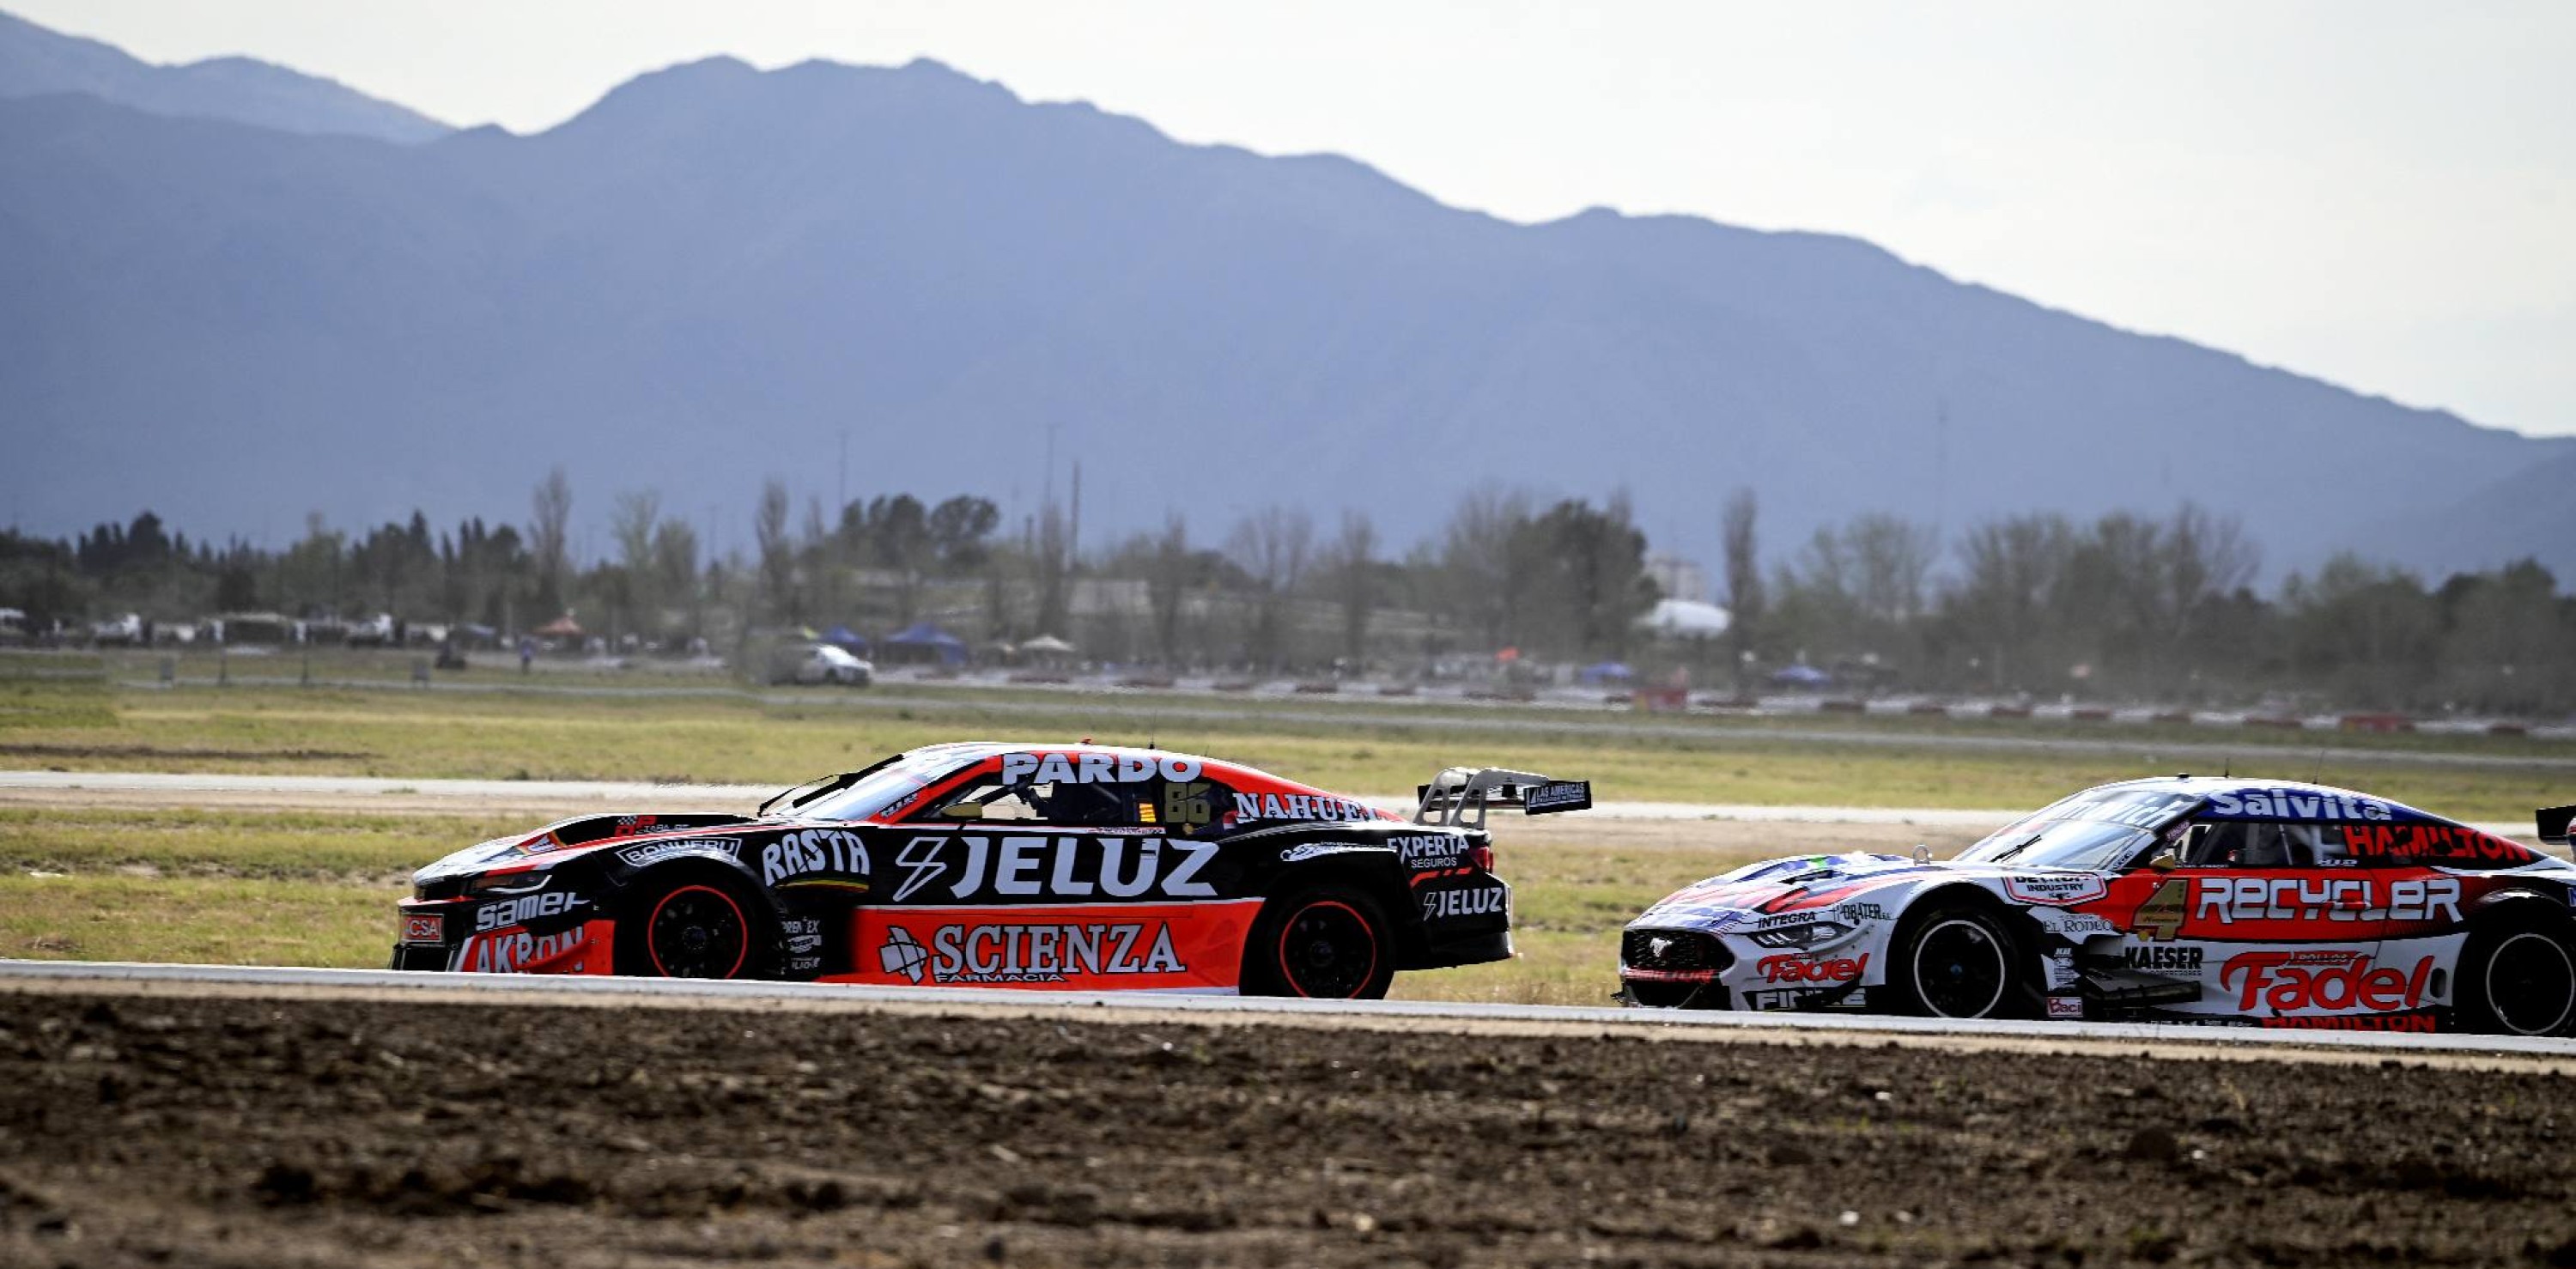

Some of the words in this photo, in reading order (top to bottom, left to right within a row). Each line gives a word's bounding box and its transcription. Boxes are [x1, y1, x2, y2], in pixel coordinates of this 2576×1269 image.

[1002, 752, 1202, 785] PARDO
[2210, 788, 2392, 821] Salvita
[762, 829, 870, 887] RASTA
[1387, 834, 1469, 864] EXPERTA
[2343, 825, 2530, 860] HAMILTON
[951, 836, 1219, 899] JELUZ
[1410, 857, 1458, 868] SEGUROS
[1436, 887, 1504, 919] JELUZ
[2026, 883, 2084, 892] INDUSTRY
[1758, 911, 1816, 928] INTEGRA
[2132, 878, 2188, 941] 4
[2063, 920, 2112, 932] RODEO
[932, 920, 1187, 975] SCIENZA
[2124, 946, 2203, 970] KAESER
[934, 972, 1066, 983] FARMACIA
[2220, 951, 2435, 1011] Fadel
